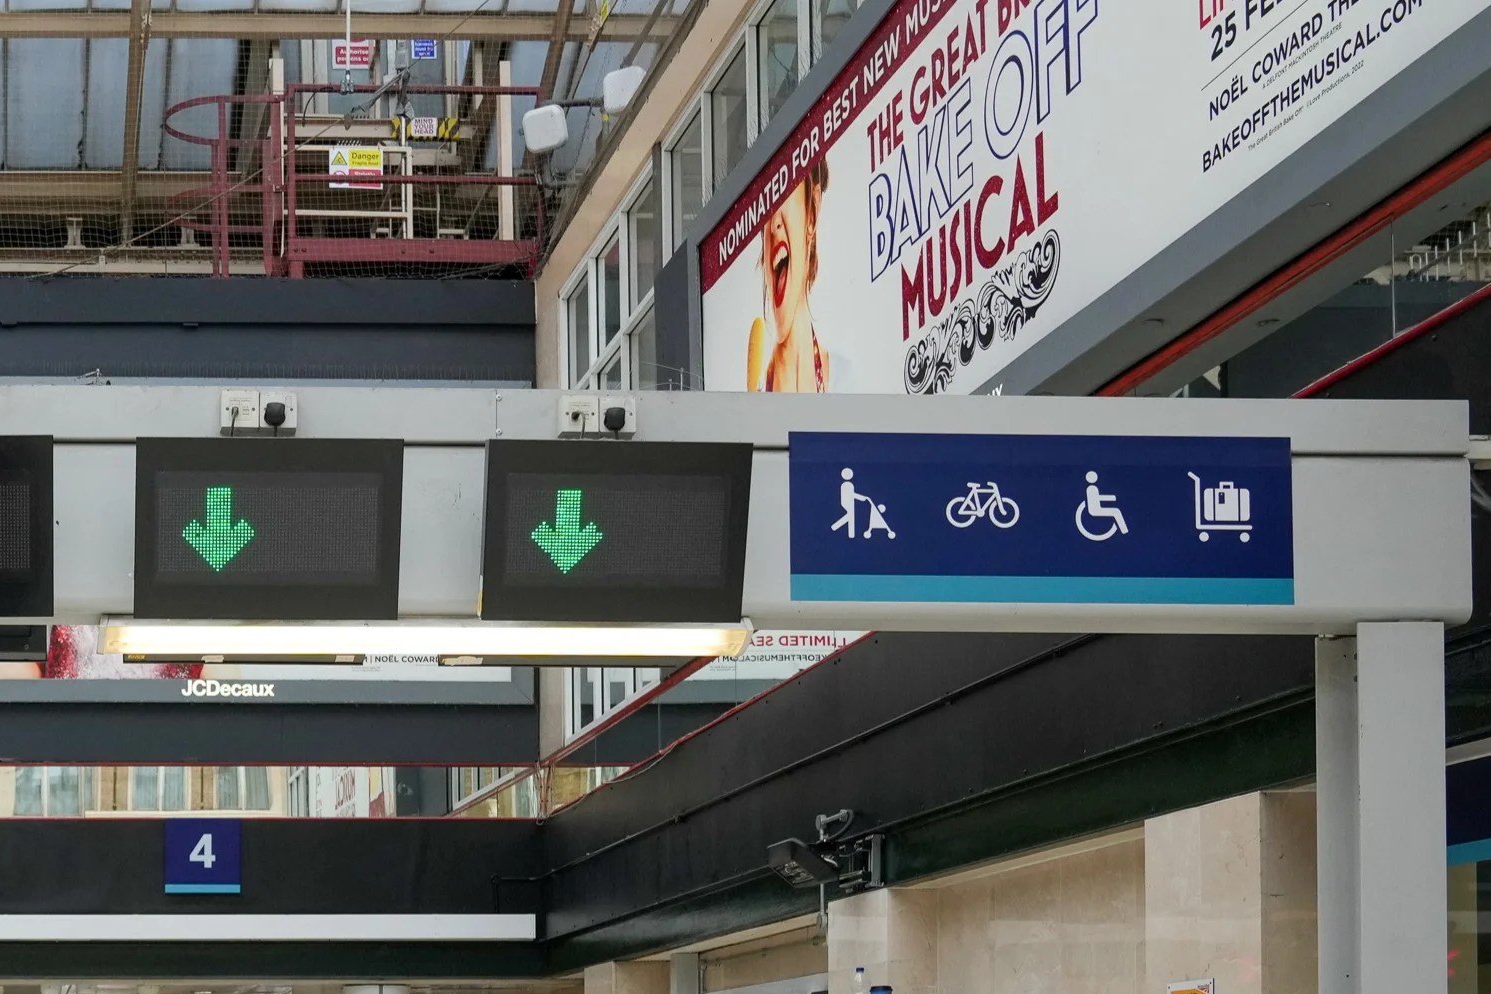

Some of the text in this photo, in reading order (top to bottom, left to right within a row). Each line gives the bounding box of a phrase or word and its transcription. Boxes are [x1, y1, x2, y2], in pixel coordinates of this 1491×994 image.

[1211, 9, 1237, 62] 25
[1319, 22, 1343, 44] THEATRE
[866, 89, 904, 173] THE
[909, 0, 989, 125] GREAT
[1209, 75, 1249, 121] NOËL
[1252, 12, 1323, 84] COWARD
[351, 152, 379, 161] Danger
[717, 164, 789, 266] NOMINATED
[791, 126, 820, 180] FOR
[822, 77, 859, 143] BEST
[862, 25, 901, 94] NEW
[868, 0, 1099, 283] BAKE OFF
[900, 130, 1060, 343] MUSICAL
[374, 654, 399, 663] NOËL
[181, 679, 275, 697] JCDecaux
[189, 833, 216, 868] 4
